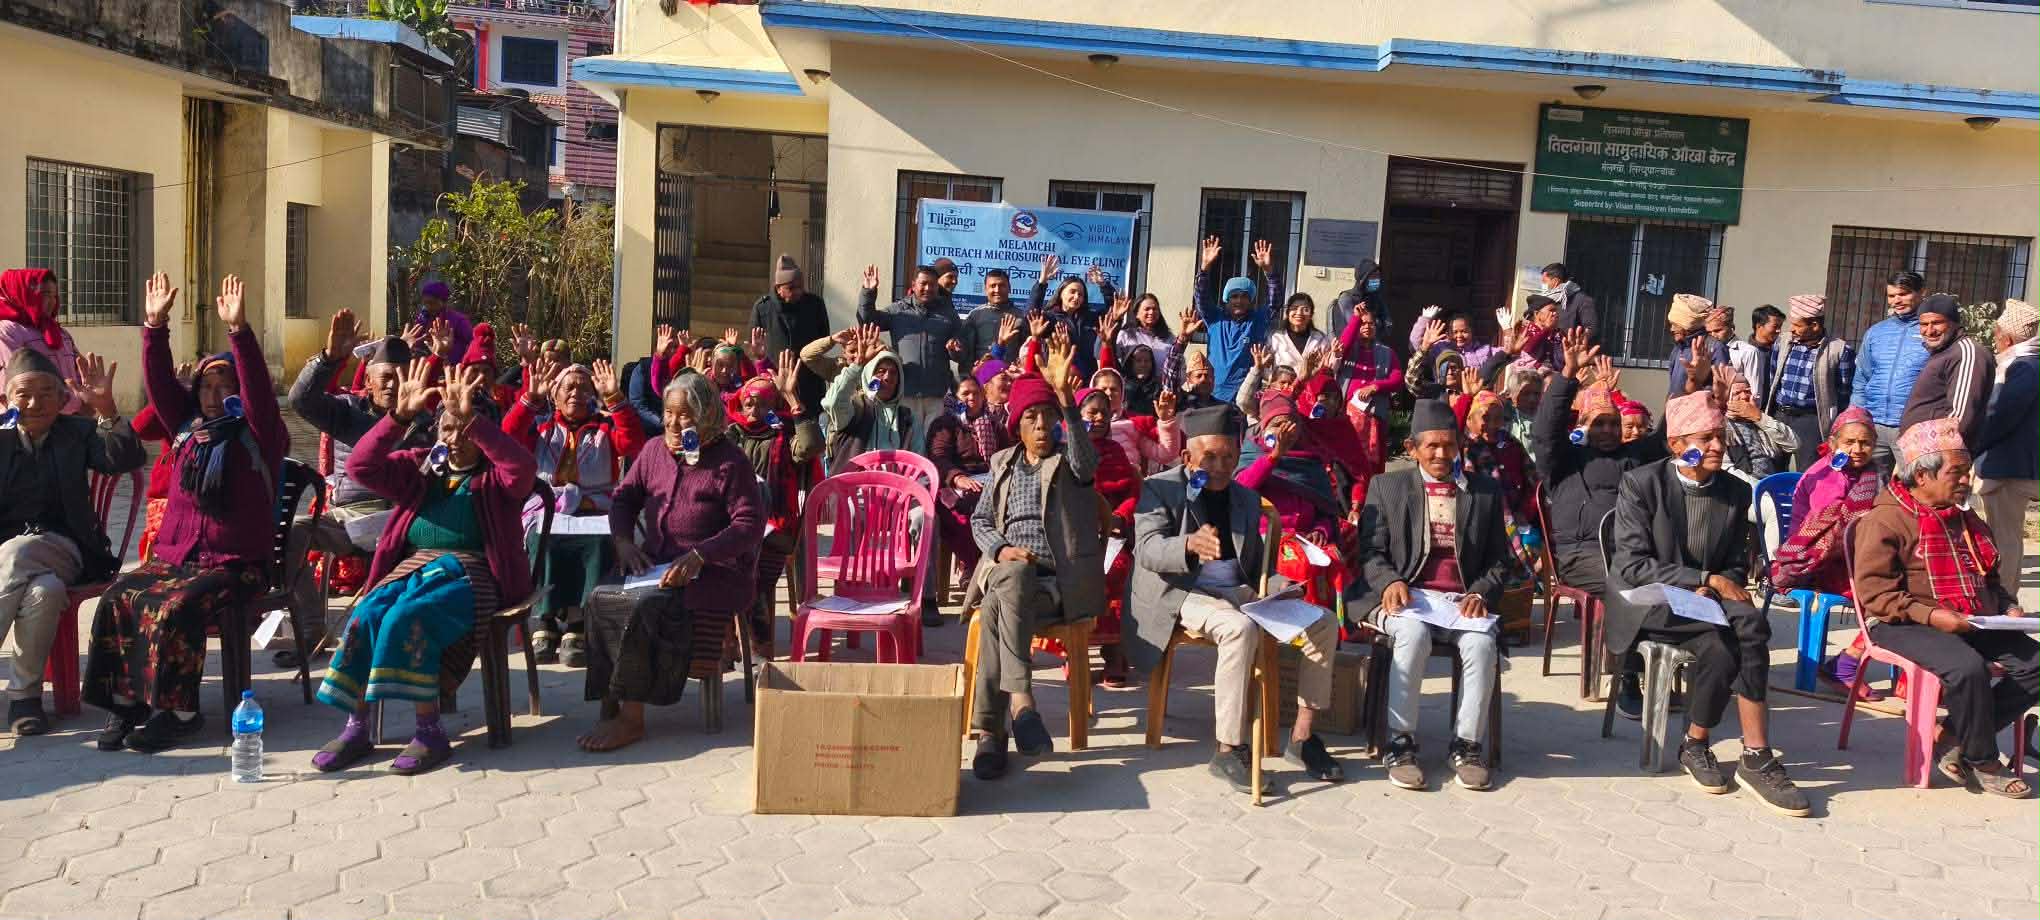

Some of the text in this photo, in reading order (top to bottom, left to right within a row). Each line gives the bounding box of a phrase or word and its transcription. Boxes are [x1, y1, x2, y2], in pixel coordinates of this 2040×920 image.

[1548, 133, 1602, 156] तिलगंगा
[1604, 141, 1669, 161] सामुदायिक
[1574, 199, 1604, 209] Supported
[928, 212, 976, 230] Tilganga
[1088, 223, 1118, 234] VISION
[998, 239, 1056, 252] MELAMCHI
[926, 245, 982, 258] OUTREACH
[1071, 255, 1090, 266] EYE
[1092, 256, 1126, 269] CLINIC
